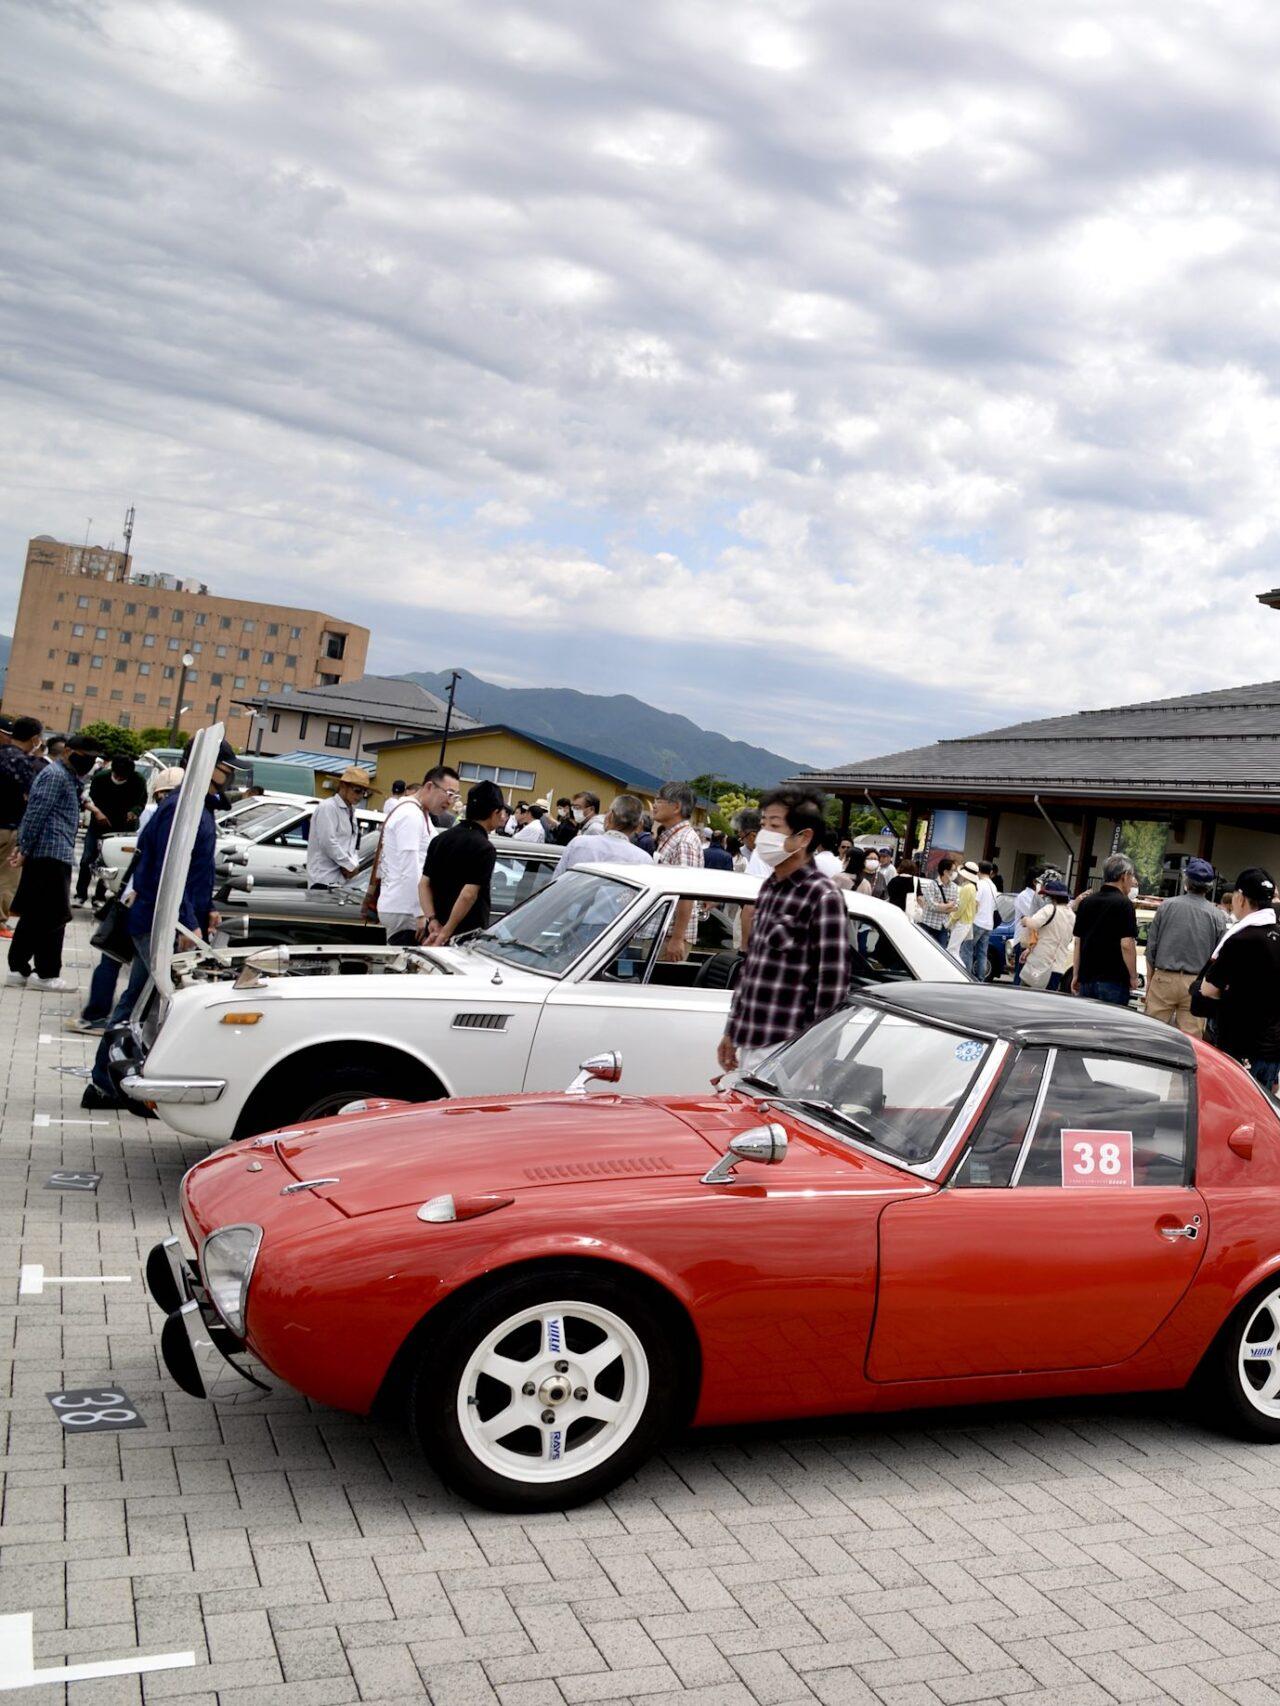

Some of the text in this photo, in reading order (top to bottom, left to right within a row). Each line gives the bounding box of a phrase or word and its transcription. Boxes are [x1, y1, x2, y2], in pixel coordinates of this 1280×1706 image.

[1072, 1142, 1122, 1175] 38
[51, 1173, 101, 1188] 37
[51, 1393, 137, 1425] 38
[552, 1431, 561, 1460] RAYS
